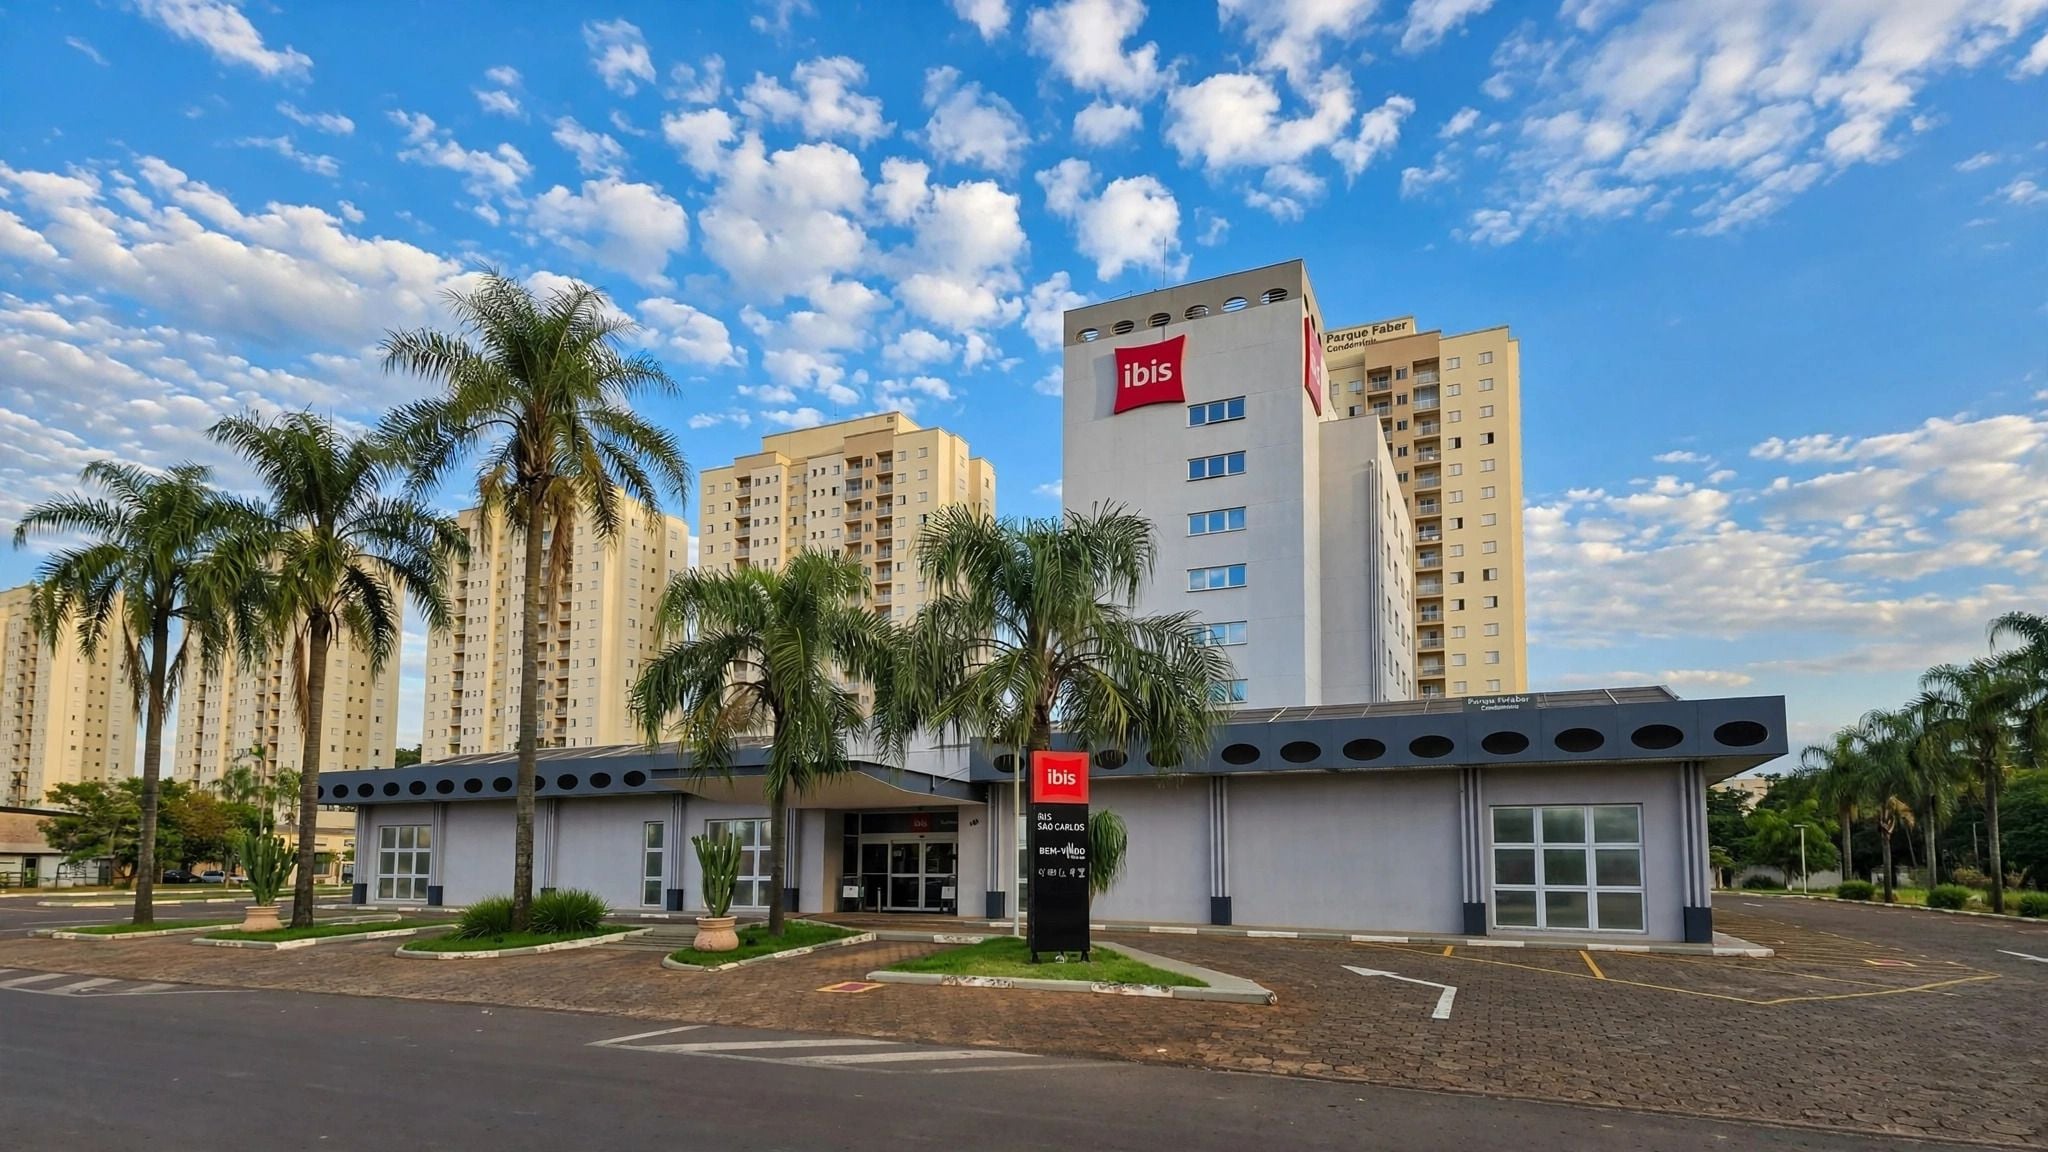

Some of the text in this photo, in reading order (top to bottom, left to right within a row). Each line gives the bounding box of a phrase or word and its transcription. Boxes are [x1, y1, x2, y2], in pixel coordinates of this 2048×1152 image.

[1326, 321, 1408, 344] Parque Faber
[1124, 358, 1173, 388] ibis
[1047, 768, 1076, 785] ibis
[1054, 822, 1085, 831] CARLOS
